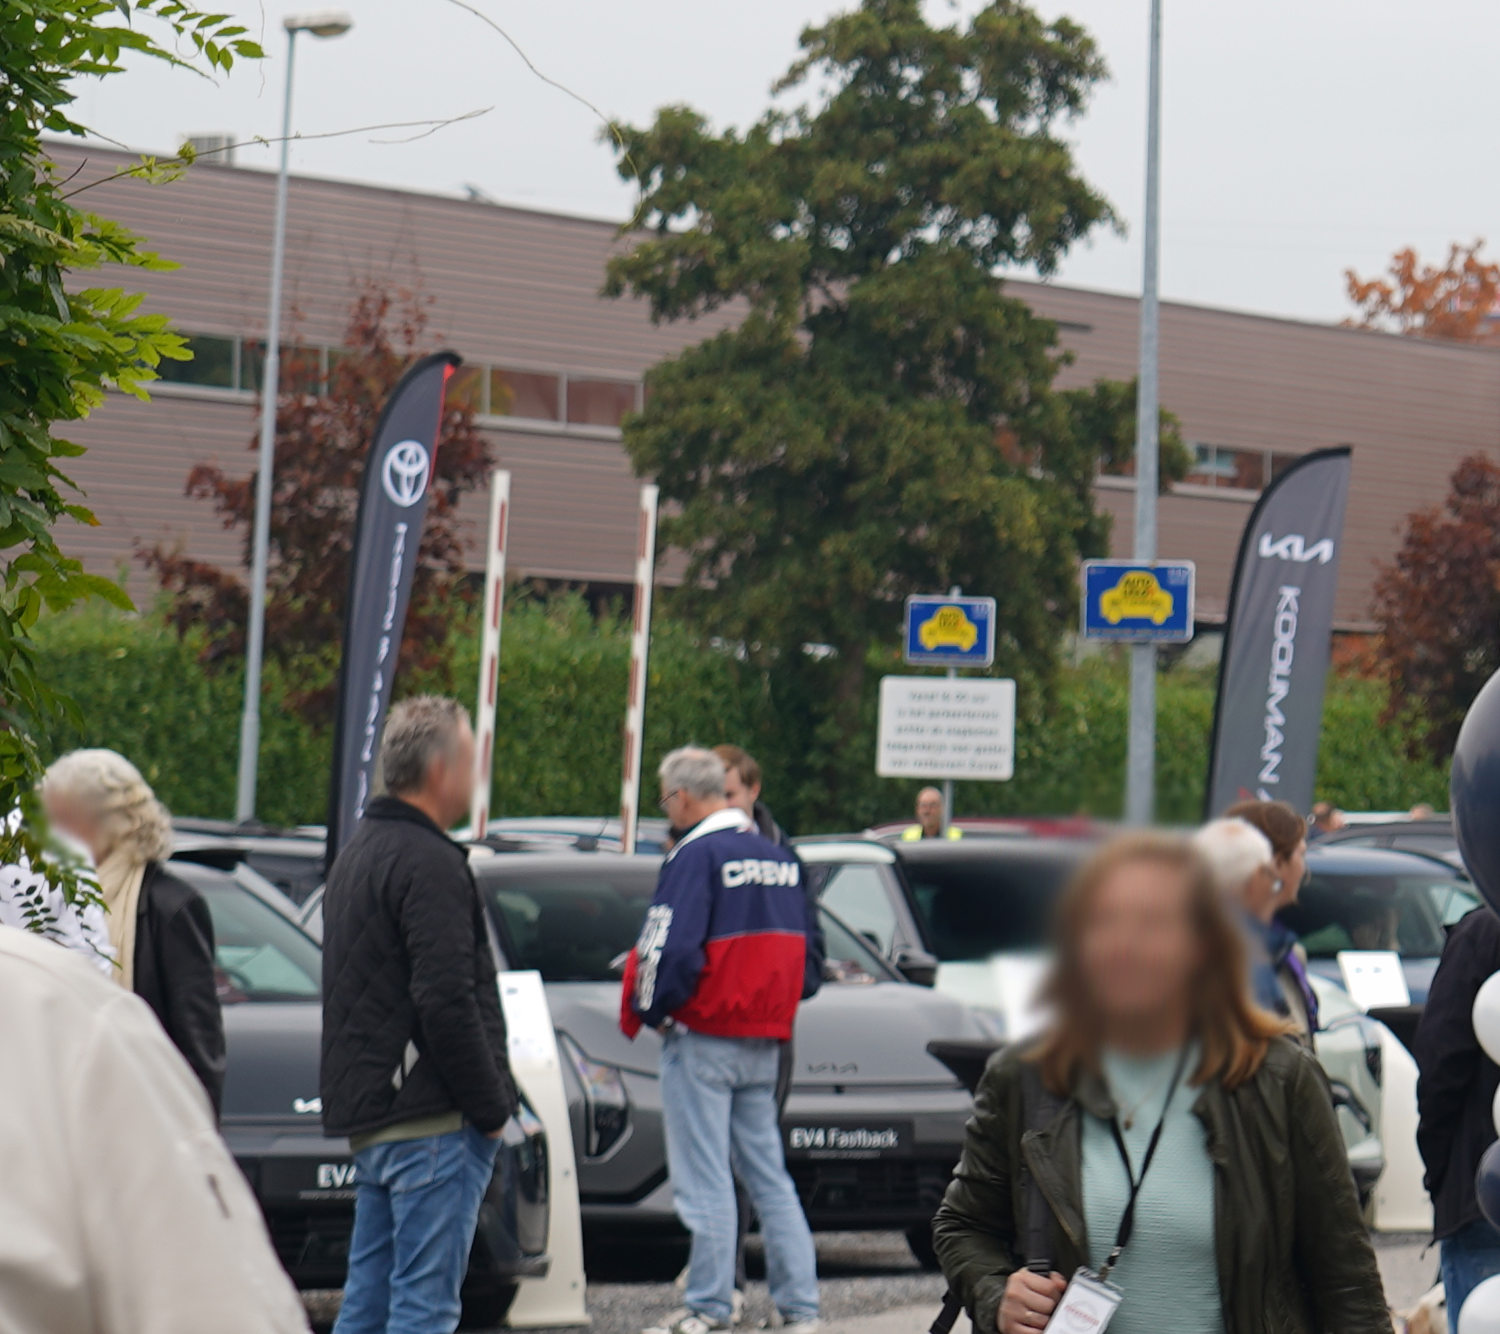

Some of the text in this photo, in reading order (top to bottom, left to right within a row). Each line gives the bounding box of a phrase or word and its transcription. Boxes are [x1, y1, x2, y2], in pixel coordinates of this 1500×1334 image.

[1258, 584, 1301, 784] KOOIJMAN
[722, 857, 800, 888] CREW
[790, 1127, 899, 1148] EV4 Fastback
